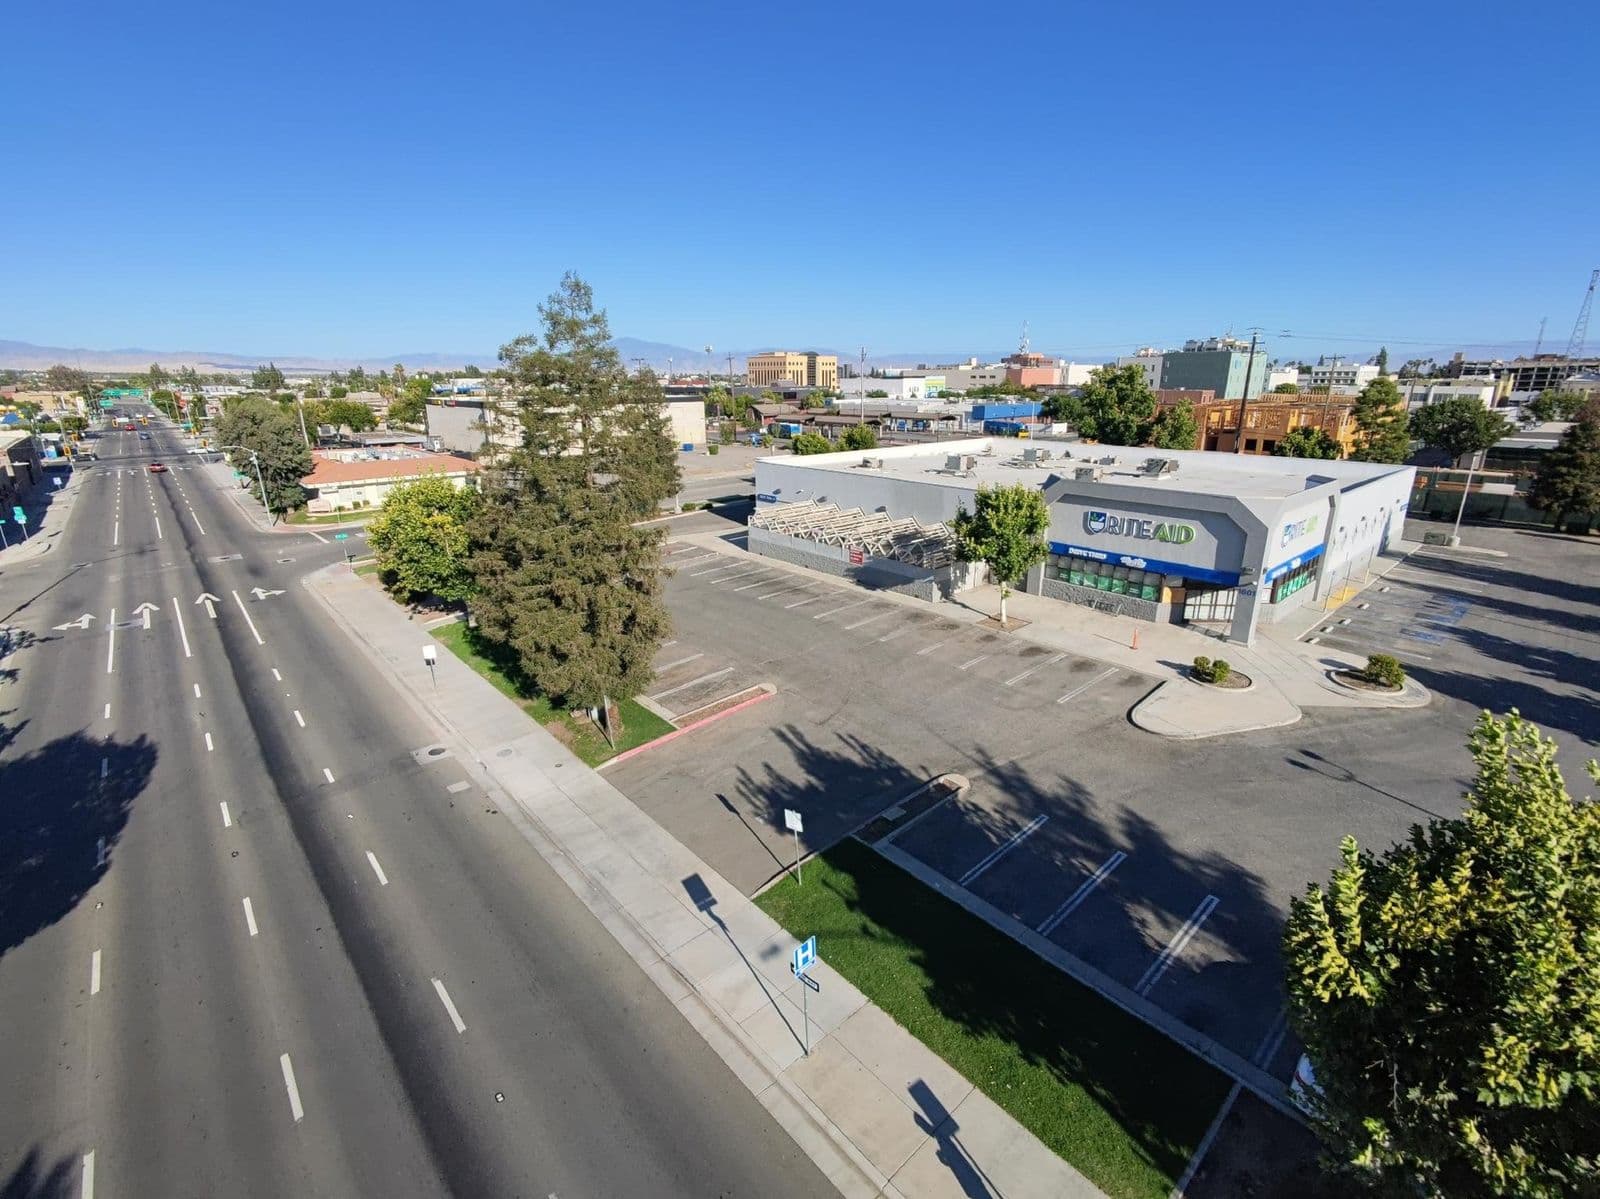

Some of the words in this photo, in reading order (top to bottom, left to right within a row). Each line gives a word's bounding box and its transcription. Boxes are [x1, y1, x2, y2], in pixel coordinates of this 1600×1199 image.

[1107, 515, 1152, 539] RITE
[1153, 521, 1197, 544] AID
[797, 938, 813, 971] H
